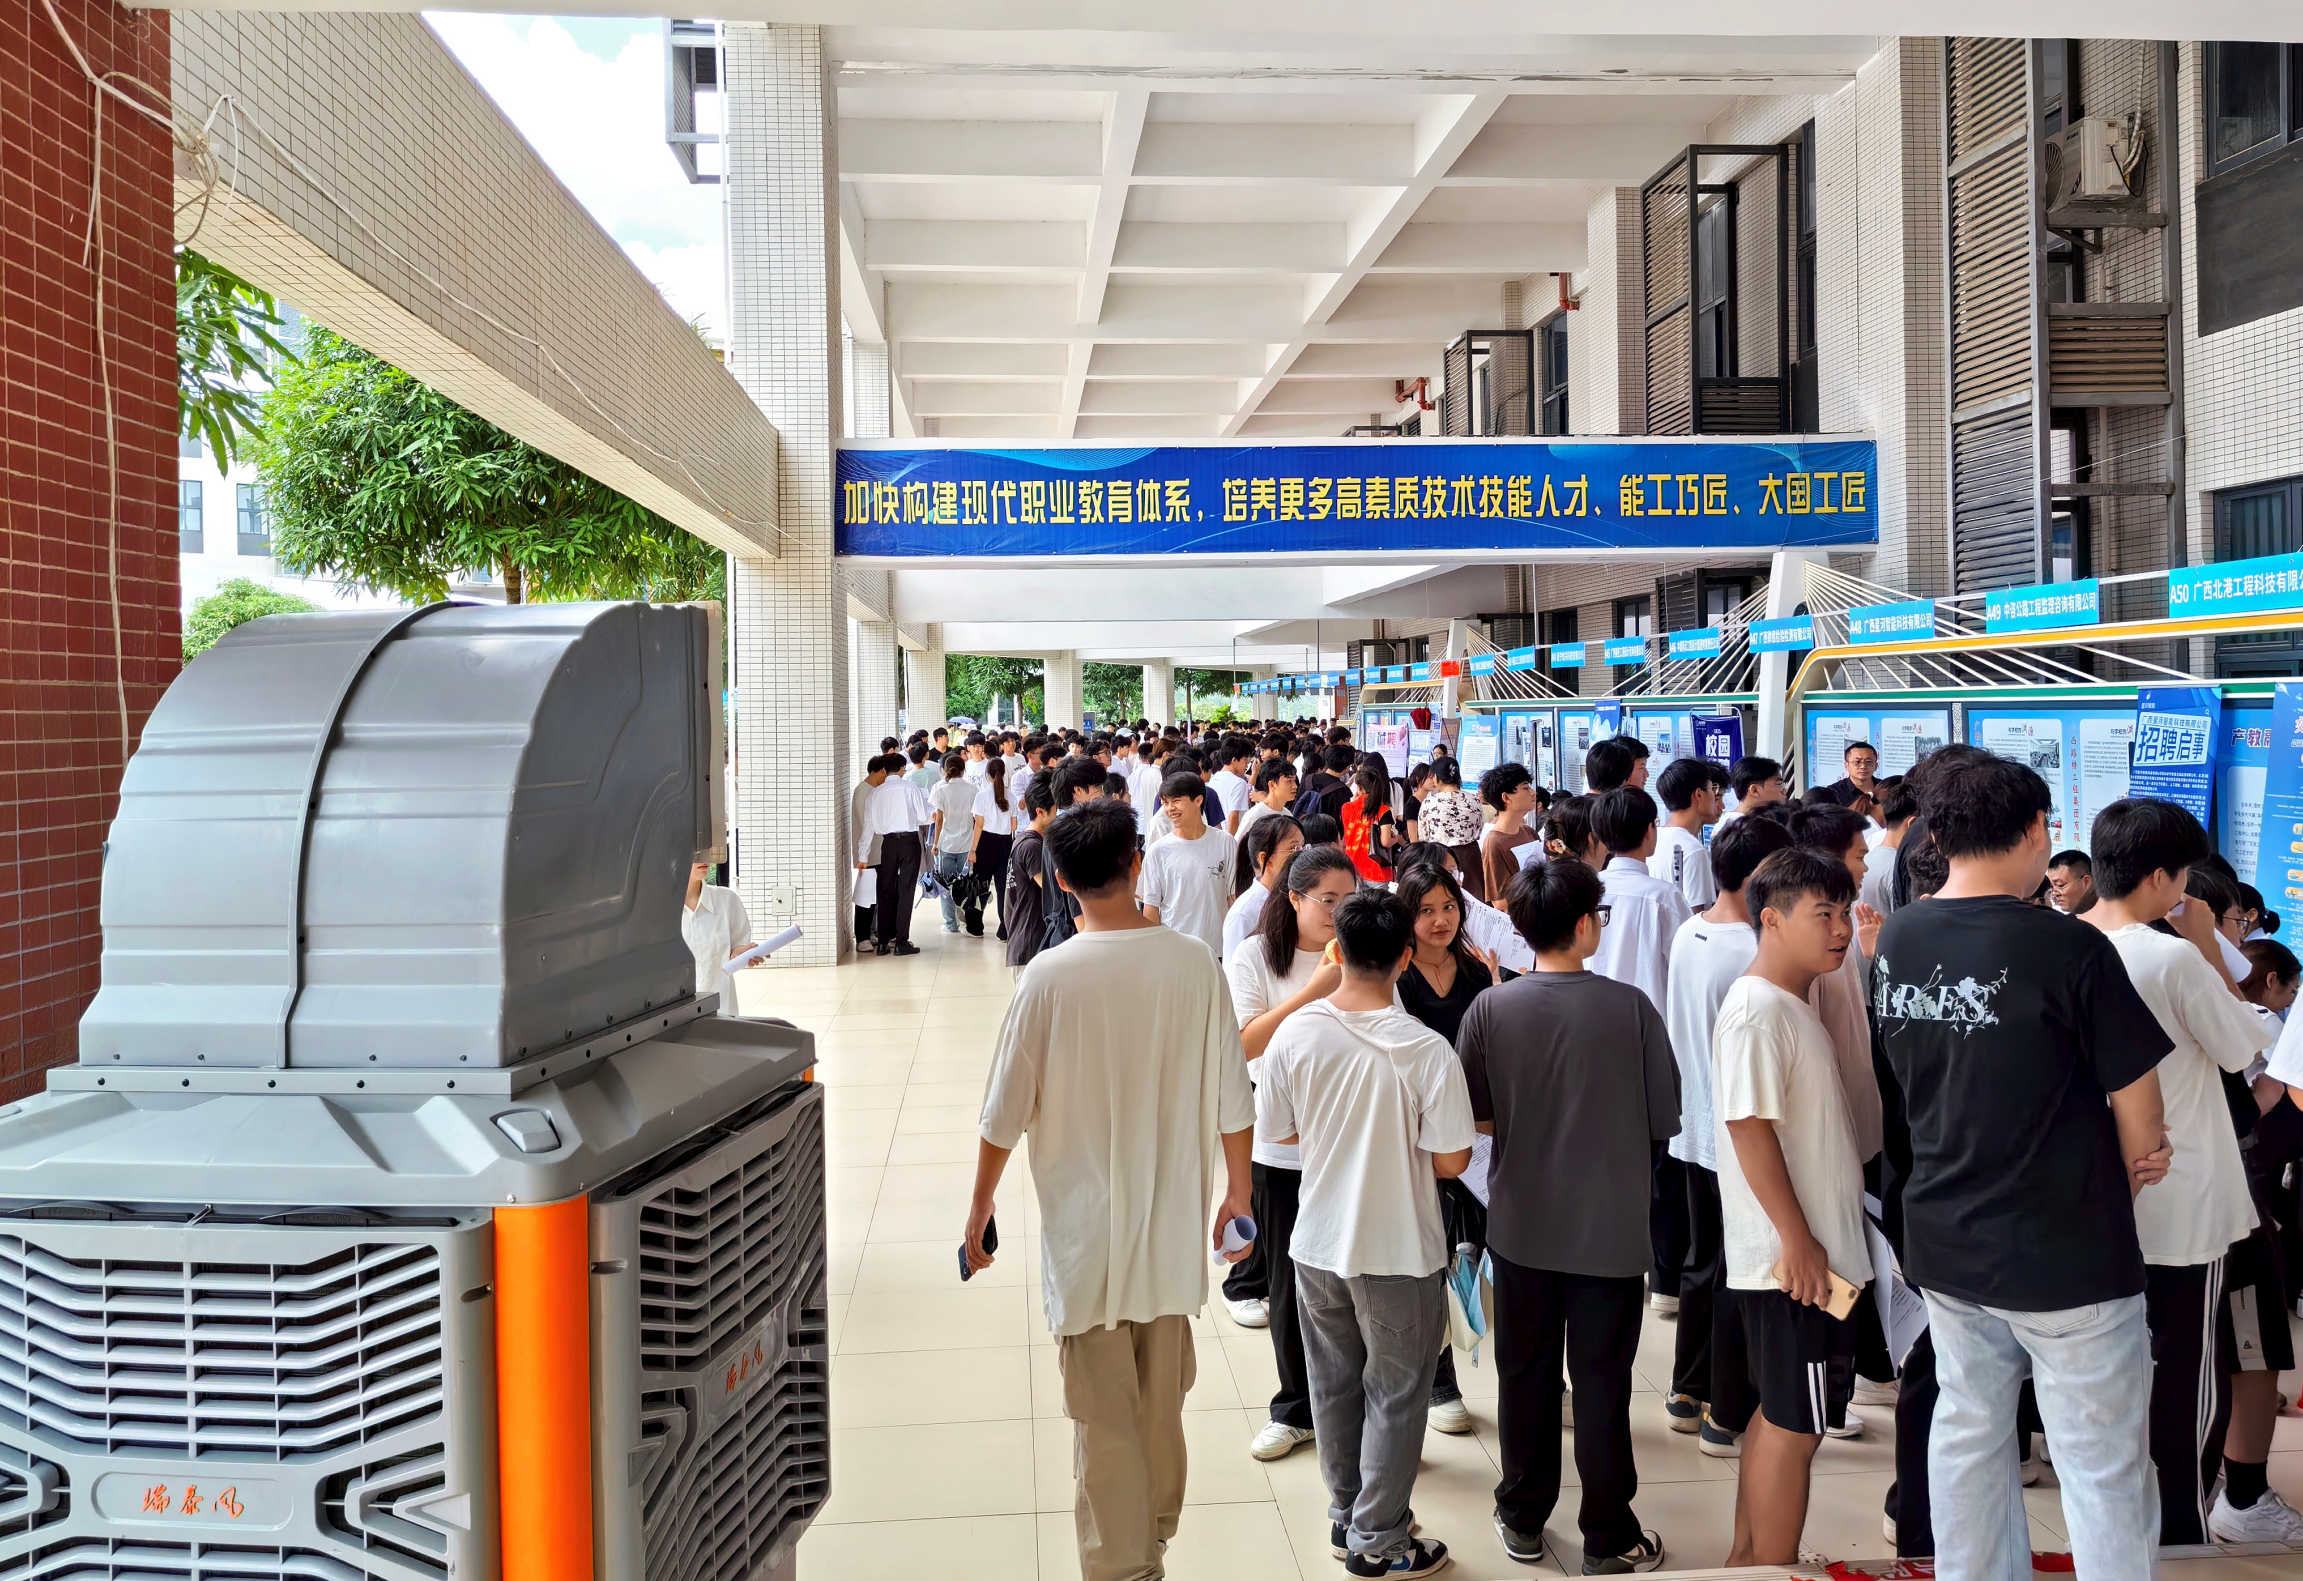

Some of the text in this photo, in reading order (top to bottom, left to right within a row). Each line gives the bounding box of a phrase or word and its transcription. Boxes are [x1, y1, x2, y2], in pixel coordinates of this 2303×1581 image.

[2169, 583, 2190, 605] A50
[1986, 604, 2001, 622] A49
[1849, 620, 1862, 635] A48
[1705, 733, 1731, 758] 校园
[2136, 724, 2206, 763] 招聘启事
